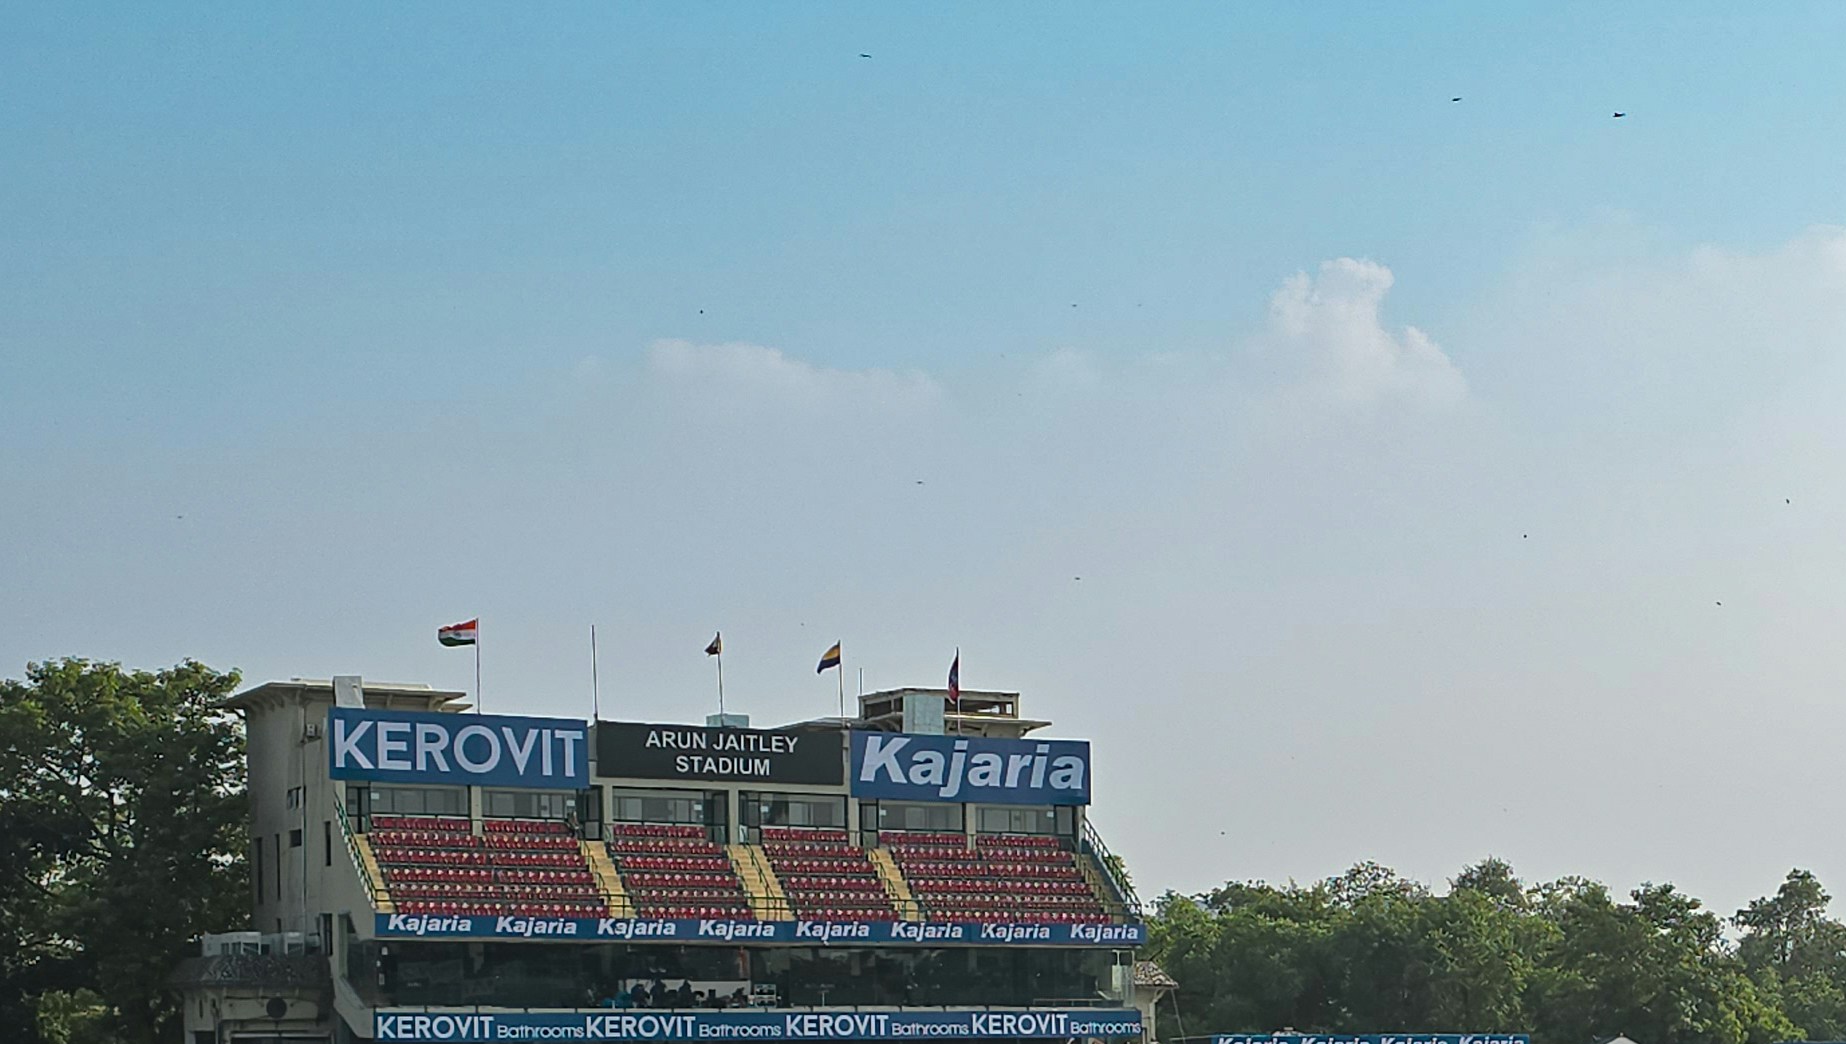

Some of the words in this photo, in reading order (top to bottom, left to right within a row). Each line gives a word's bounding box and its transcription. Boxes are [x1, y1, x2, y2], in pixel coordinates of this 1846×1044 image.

[334, 718, 584, 778] KEROVIT
[645, 729, 706, 751] ARUN
[711, 732, 798, 754] JAITLEY
[675, 755, 771, 776] STADIUM
[860, 736, 1085, 797] Kajaria
[388, 914, 472, 936] Kajaria
[495, 916, 577, 937] Kajaria
[597, 917, 676, 939] Kajaria
[698, 919, 775, 939] Kajaria
[796, 921, 870, 941] Kajaria
[891, 921, 963, 940] Kajaria
[981, 922, 1049, 941] Kajaria
[1070, 923, 1138, 941] Kajaria
[376, 1015, 495, 1039] KEROVIT
[497, 1024, 584, 1038] Bathrooms
[586, 1015, 696, 1038] KEROVIT
[699, 1023, 781, 1037] Bathrooms
[785, 1014, 890, 1037] KEROVIT
[891, 1022, 969, 1035] Bathrooms
[972, 1013, 1068, 1035] KEROVIT
[1070, 1020, 1141, 1034] Bathrooms
